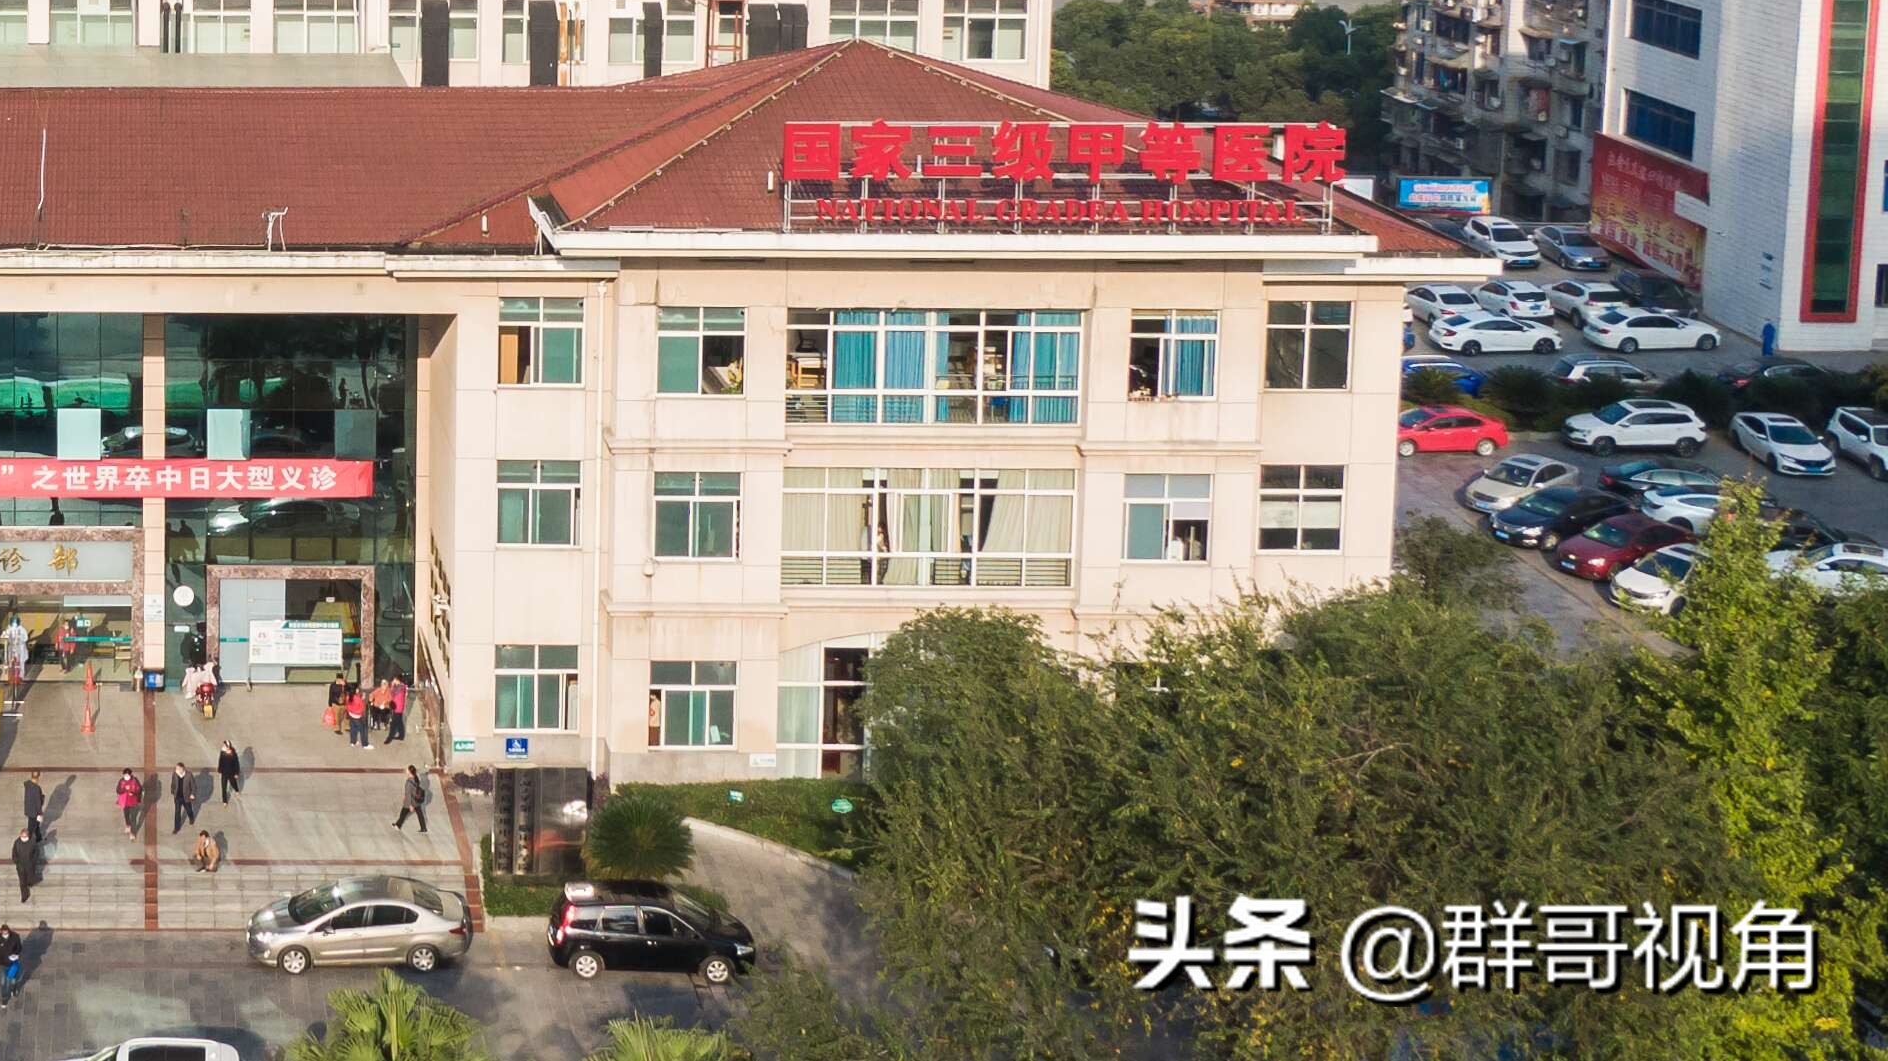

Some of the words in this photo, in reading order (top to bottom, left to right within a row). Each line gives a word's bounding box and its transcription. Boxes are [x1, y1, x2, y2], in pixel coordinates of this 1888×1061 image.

[783, 119, 1348, 183] 国家三级甲等医院
[816, 198, 985, 222] NATIONAL
[1140, 200, 1304, 225] HOSPITAL
